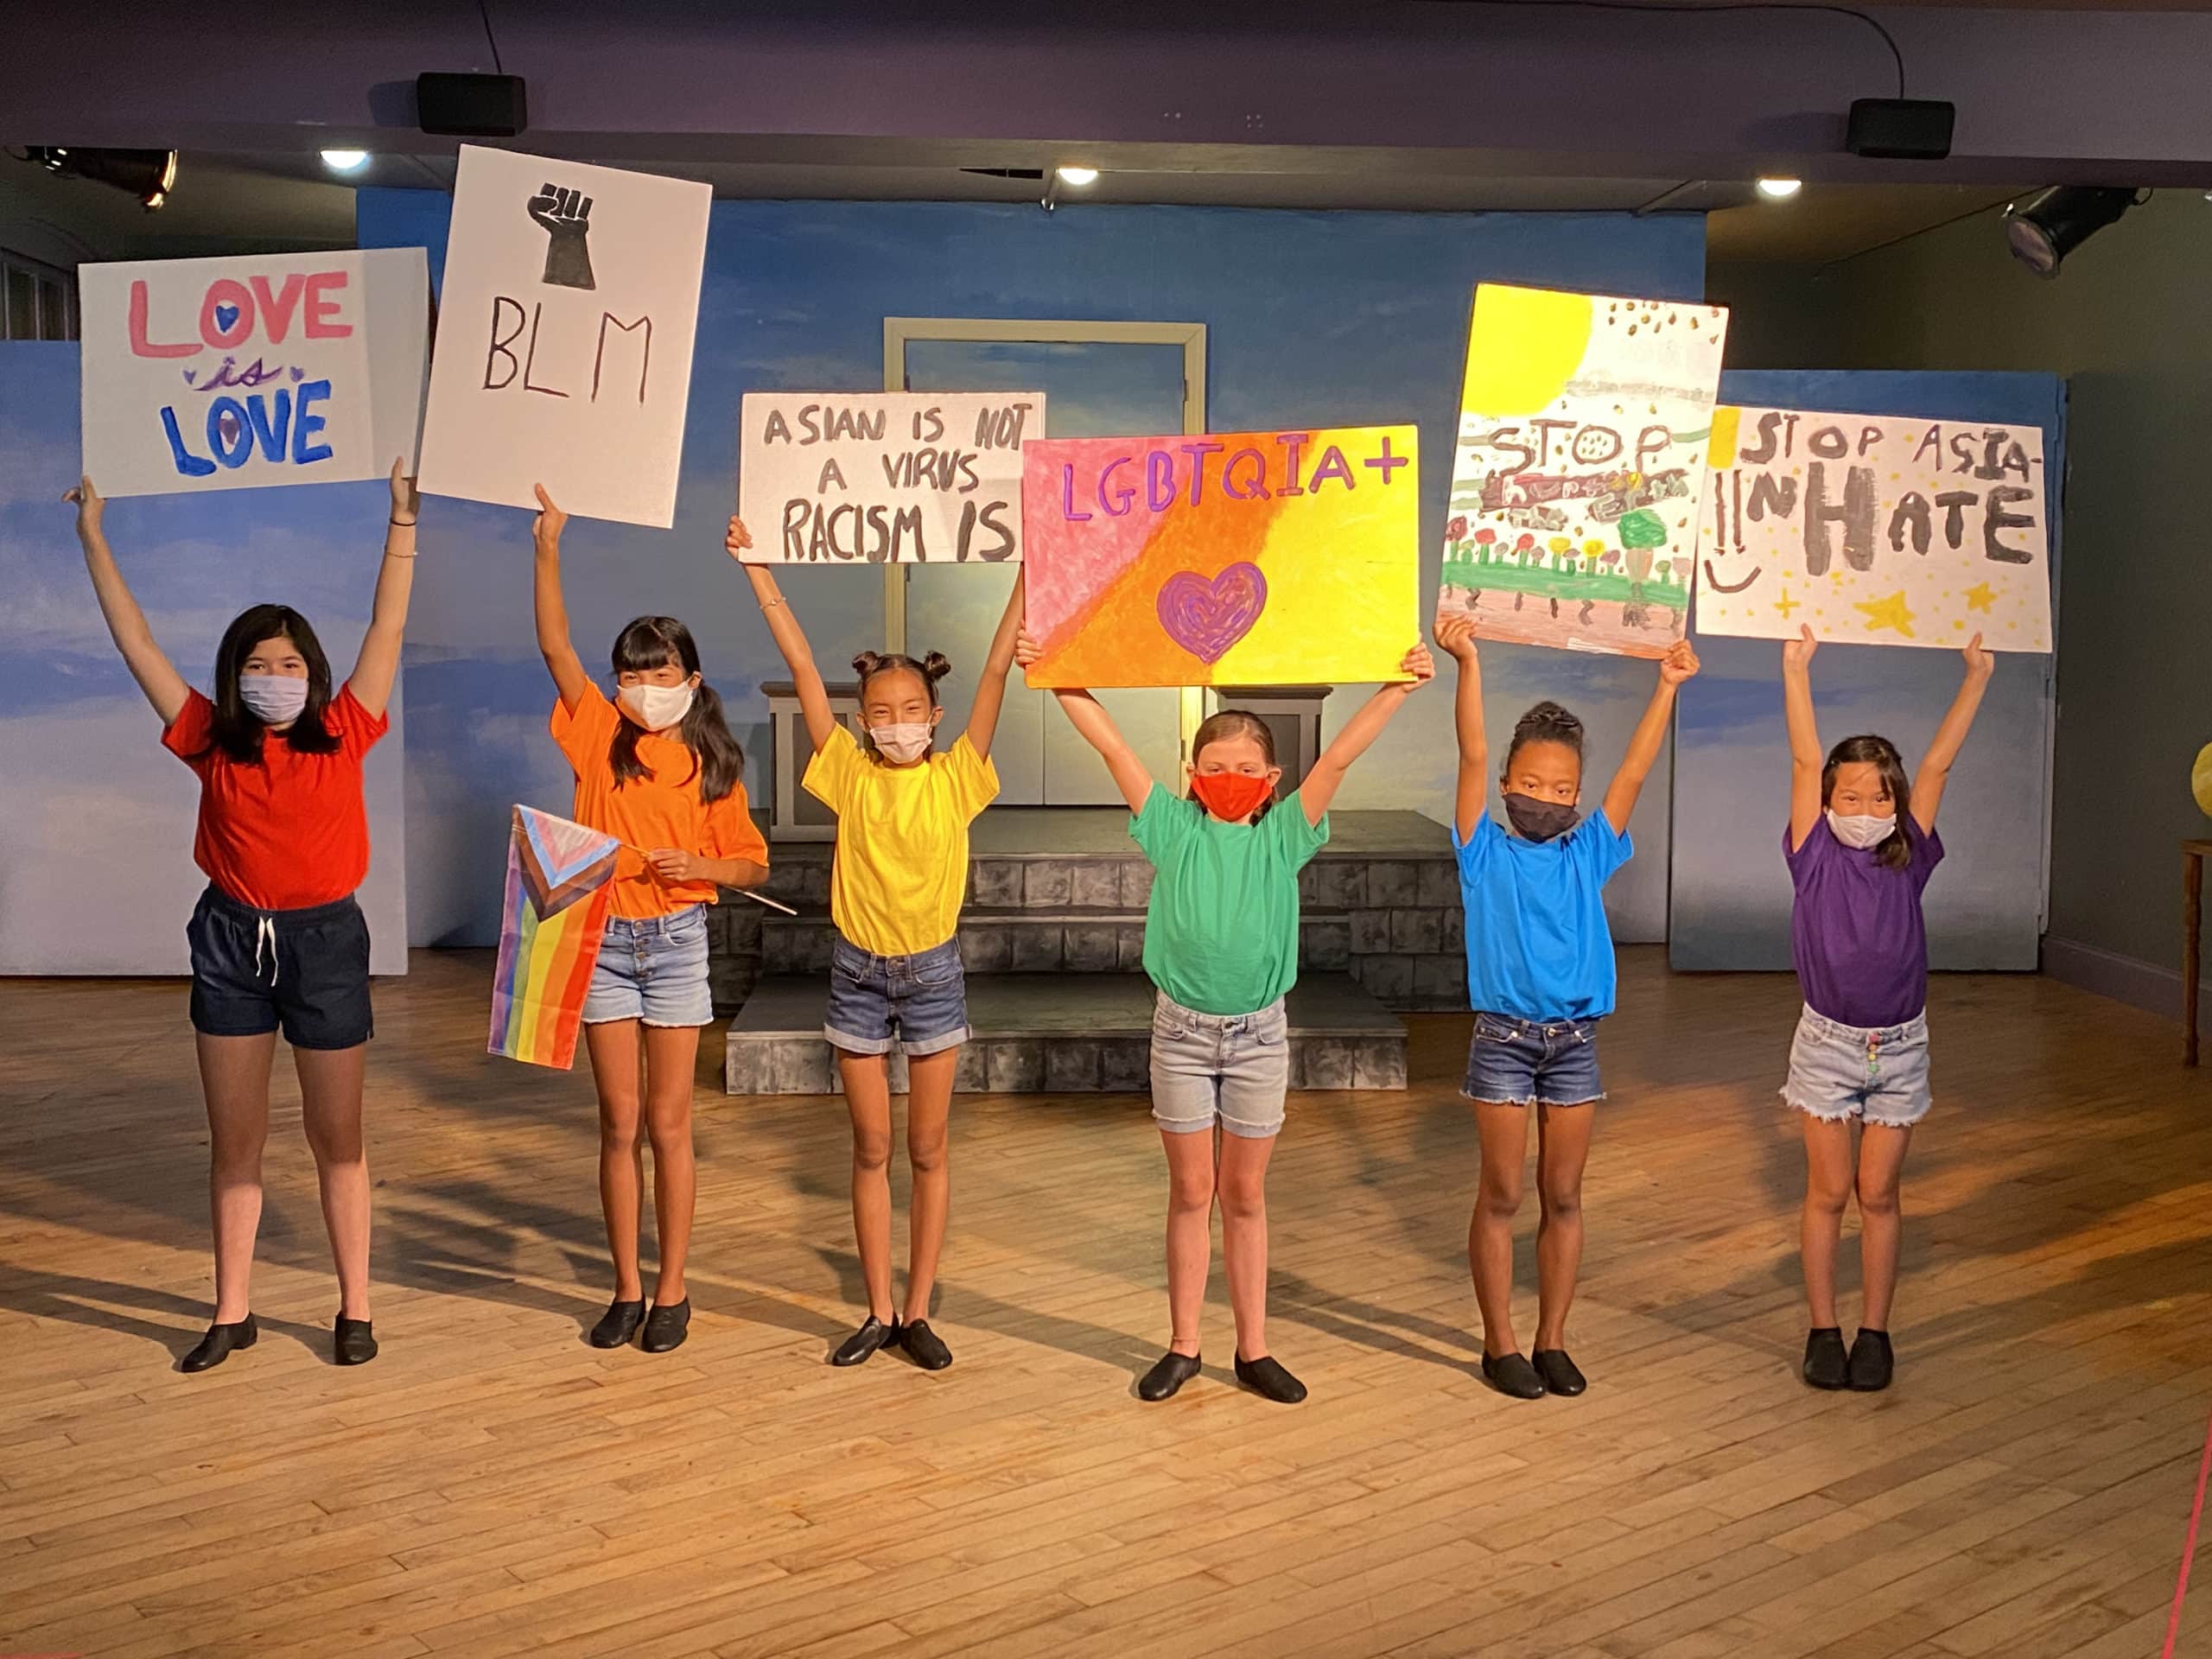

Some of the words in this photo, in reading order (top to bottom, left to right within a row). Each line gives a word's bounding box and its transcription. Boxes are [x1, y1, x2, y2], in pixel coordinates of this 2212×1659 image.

[129, 270, 353, 359] LOVE
[193, 356, 283, 391] is
[160, 378, 334, 477] LOVE
[764, 404, 887, 445] ASIAN
[912, 406, 945, 443] IS
[975, 403, 1033, 451] NOT
[1487, 418, 1673, 478] STOP
[1739, 411, 1885, 465] STOP
[817, 458, 848, 494] A
[881, 448, 980, 494] VIRUS
[1063, 434, 1409, 521] LGBTQIA+
[782, 498, 926, 563] RACISM
[956, 499, 1017, 563] IS
[1803, 461, 2037, 577] HATE
